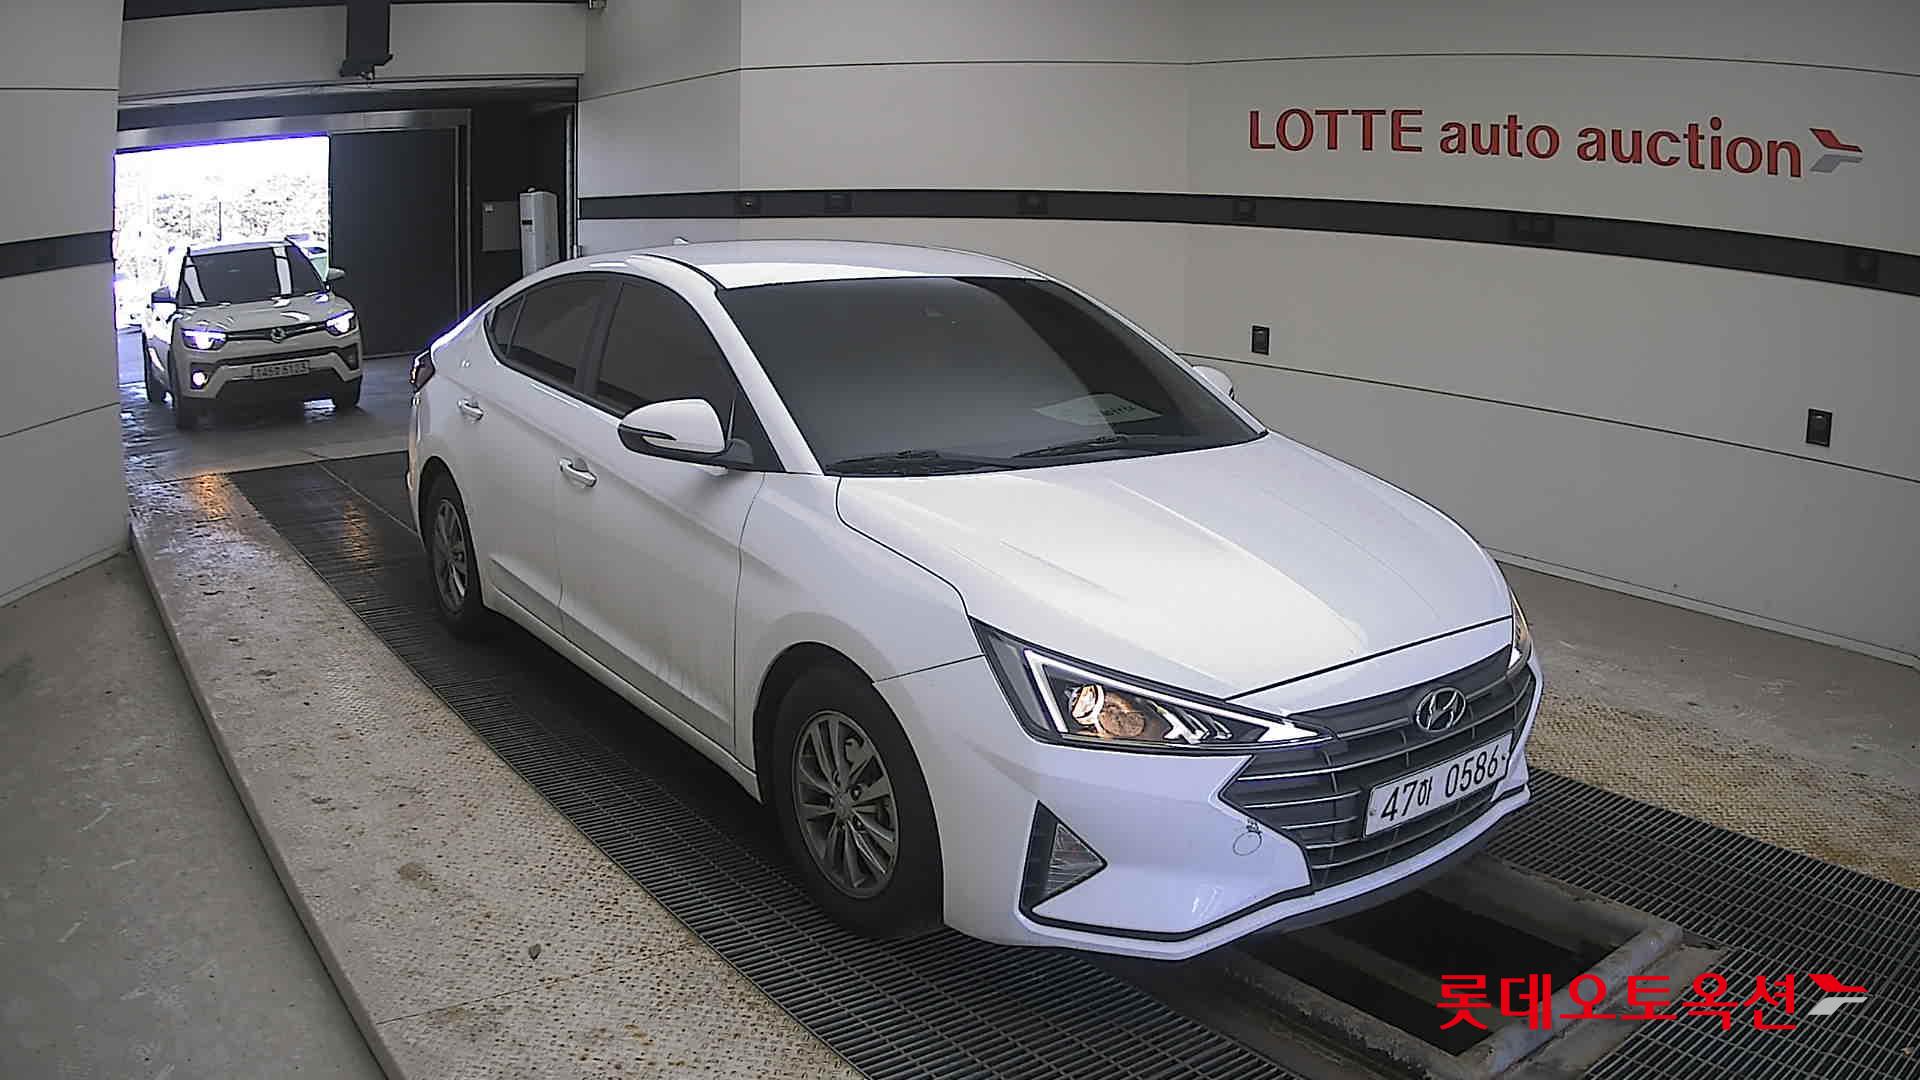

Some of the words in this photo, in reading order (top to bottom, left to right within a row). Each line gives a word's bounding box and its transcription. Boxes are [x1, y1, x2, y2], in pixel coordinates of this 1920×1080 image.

[1249, 109, 1424, 153] LOTTE
[1439, 114, 1560, 160] auto
[1576, 117, 1803, 178] auction
[1380, 775, 1434, 822] 47하
[1444, 743, 1500, 798] 0586
